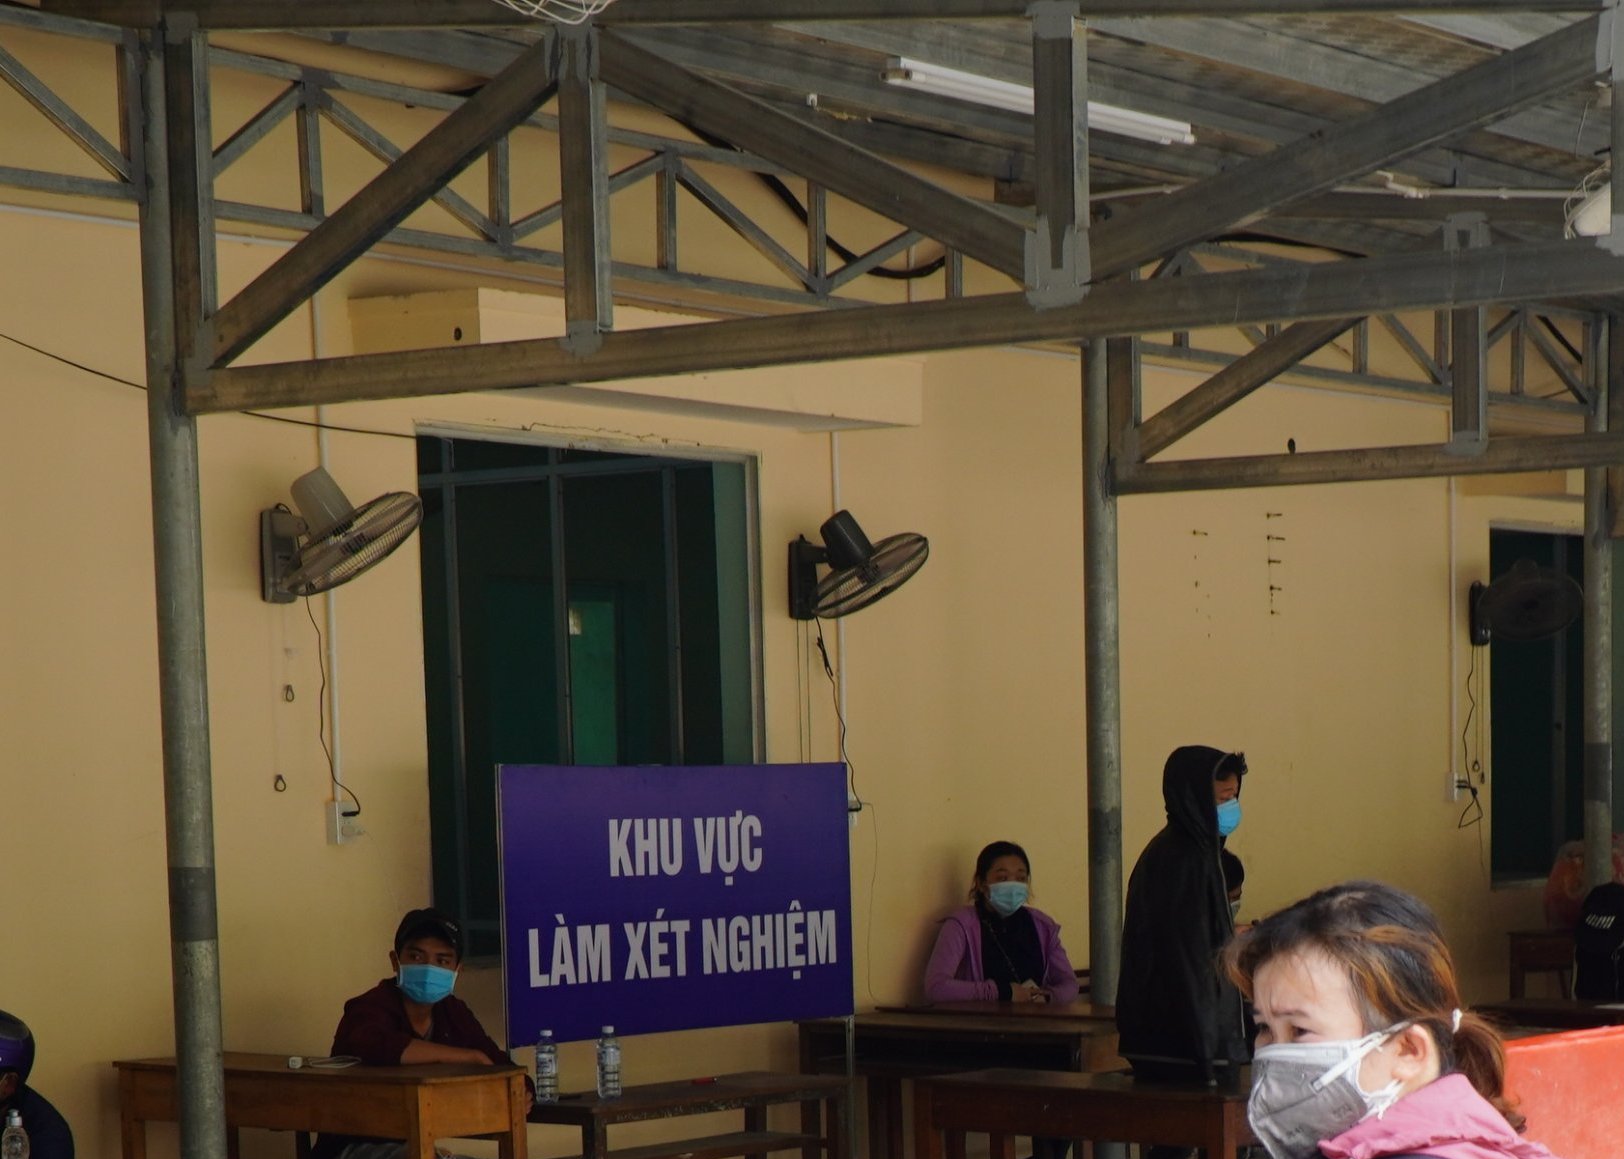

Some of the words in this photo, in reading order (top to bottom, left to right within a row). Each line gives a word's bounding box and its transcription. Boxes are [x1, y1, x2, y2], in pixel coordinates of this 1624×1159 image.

[608, 818, 683, 877] KHU
[693, 809, 763, 886] VỰC
[528, 913, 612, 988] LÀM
[623, 908, 691, 981] XÉT
[701, 899, 837, 980] NGHIỆM
